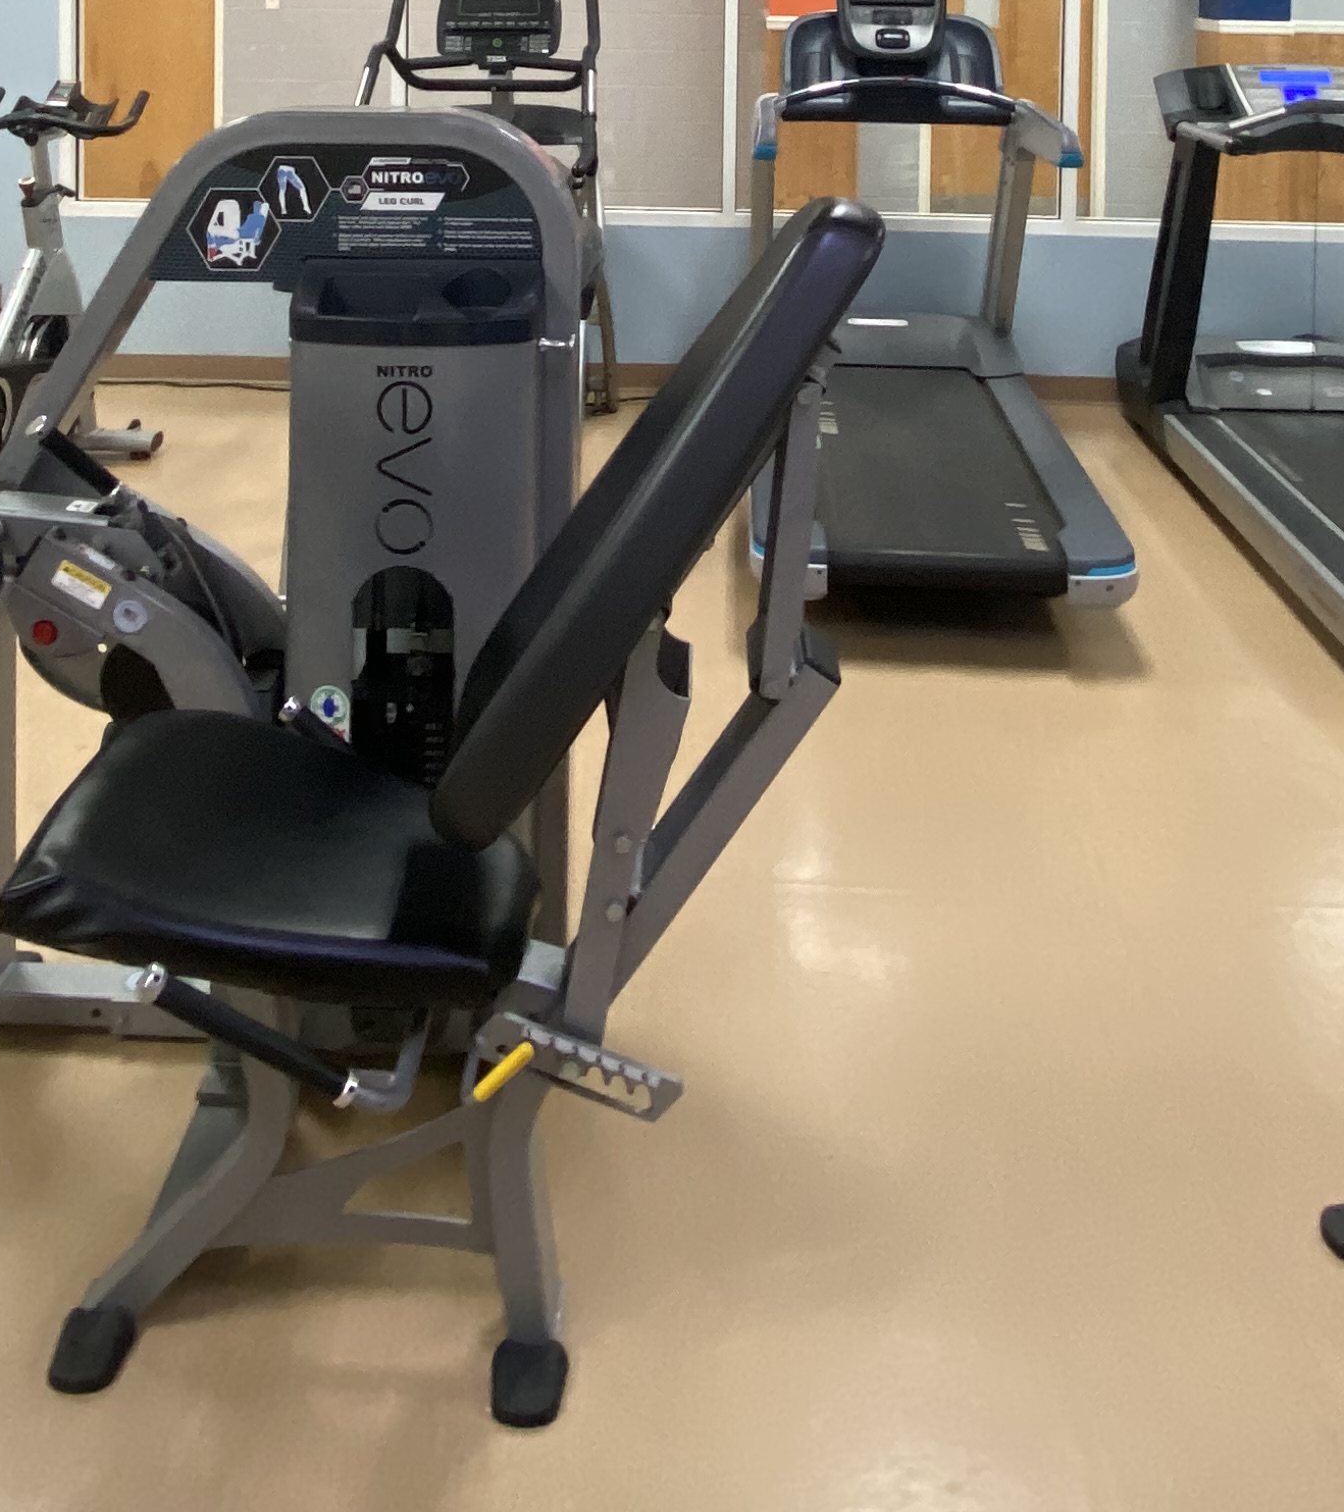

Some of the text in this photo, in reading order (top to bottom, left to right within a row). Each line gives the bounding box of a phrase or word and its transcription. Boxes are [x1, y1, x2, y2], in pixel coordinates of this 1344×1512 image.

[370, 171, 424, 184] NITRO
[376, 365, 433, 378] NITRO
[374, 380, 435, 556] evo
